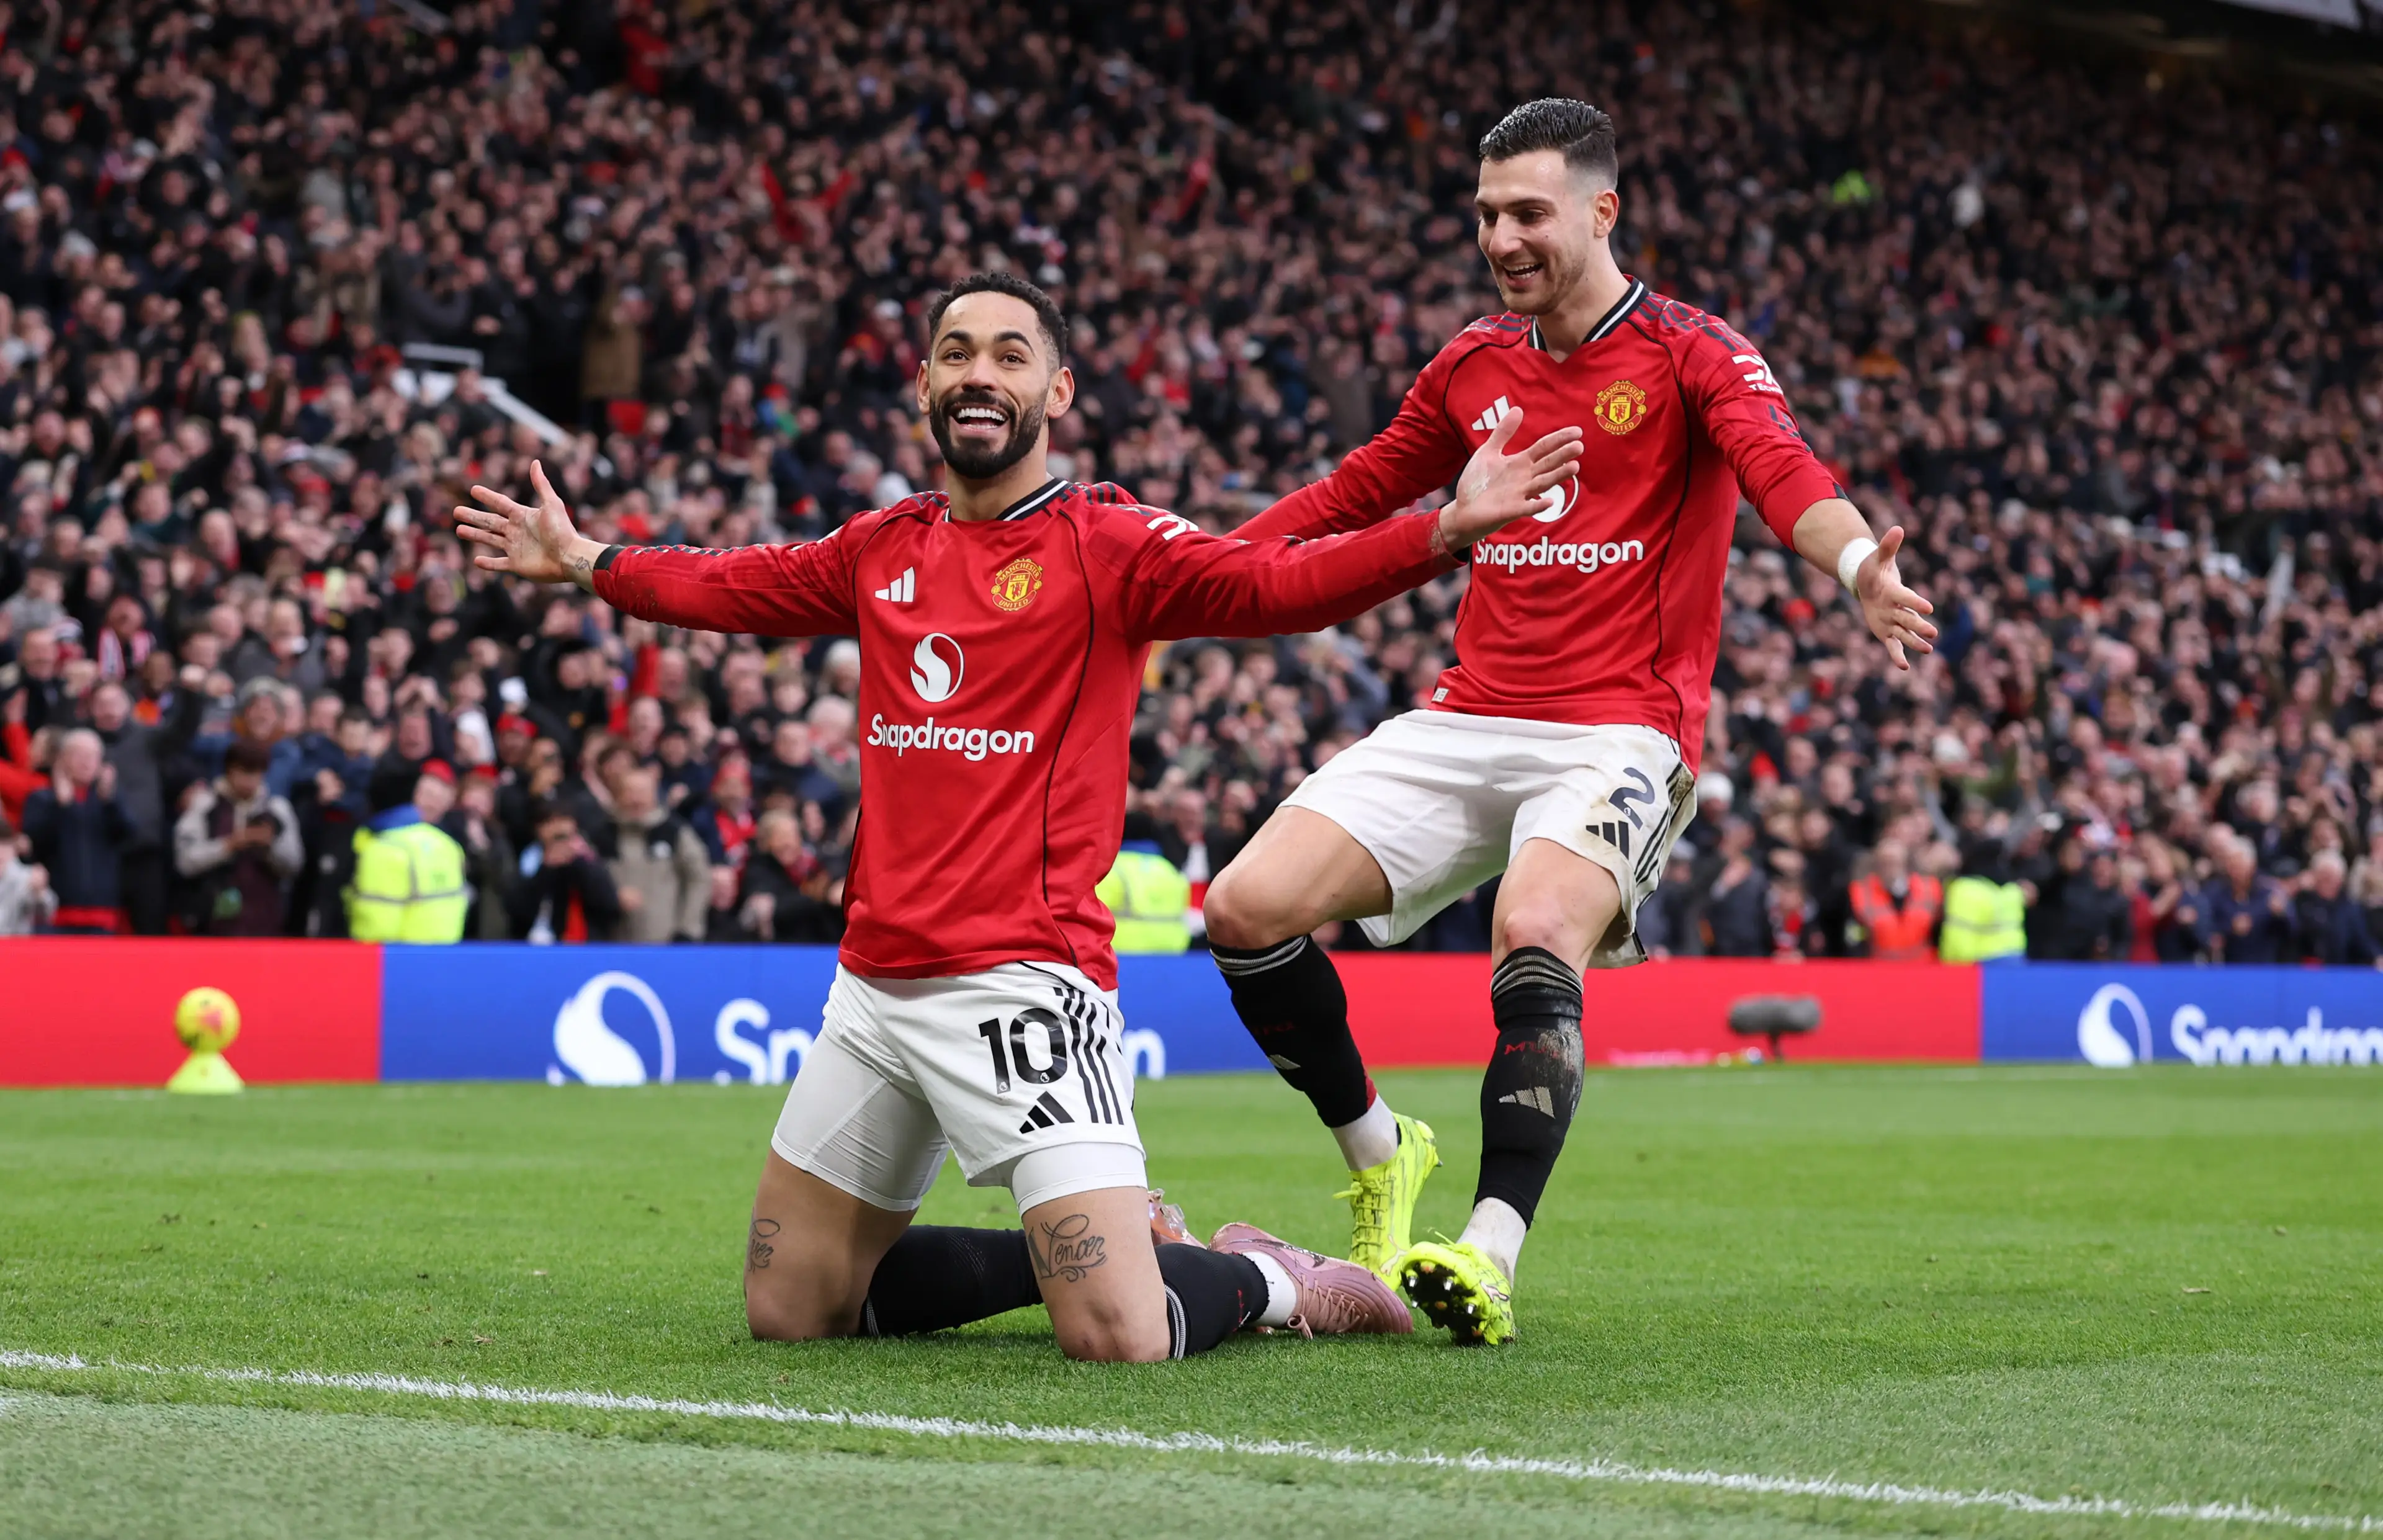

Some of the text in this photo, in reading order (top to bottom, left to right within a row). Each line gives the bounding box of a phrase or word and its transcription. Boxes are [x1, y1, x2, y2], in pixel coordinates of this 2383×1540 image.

[1601, 385, 1642, 402] MANCHESTER
[1605, 422, 1635, 431] UNITED
[1475, 536, 1643, 574] Snapdragon
[999, 562, 1039, 581] MANCHESTER
[999, 599, 1028, 608] UNITED
[868, 714, 1034, 761] Snapdragon
[1608, 767, 1655, 831] 2
[978, 1008, 1067, 1095] 10
